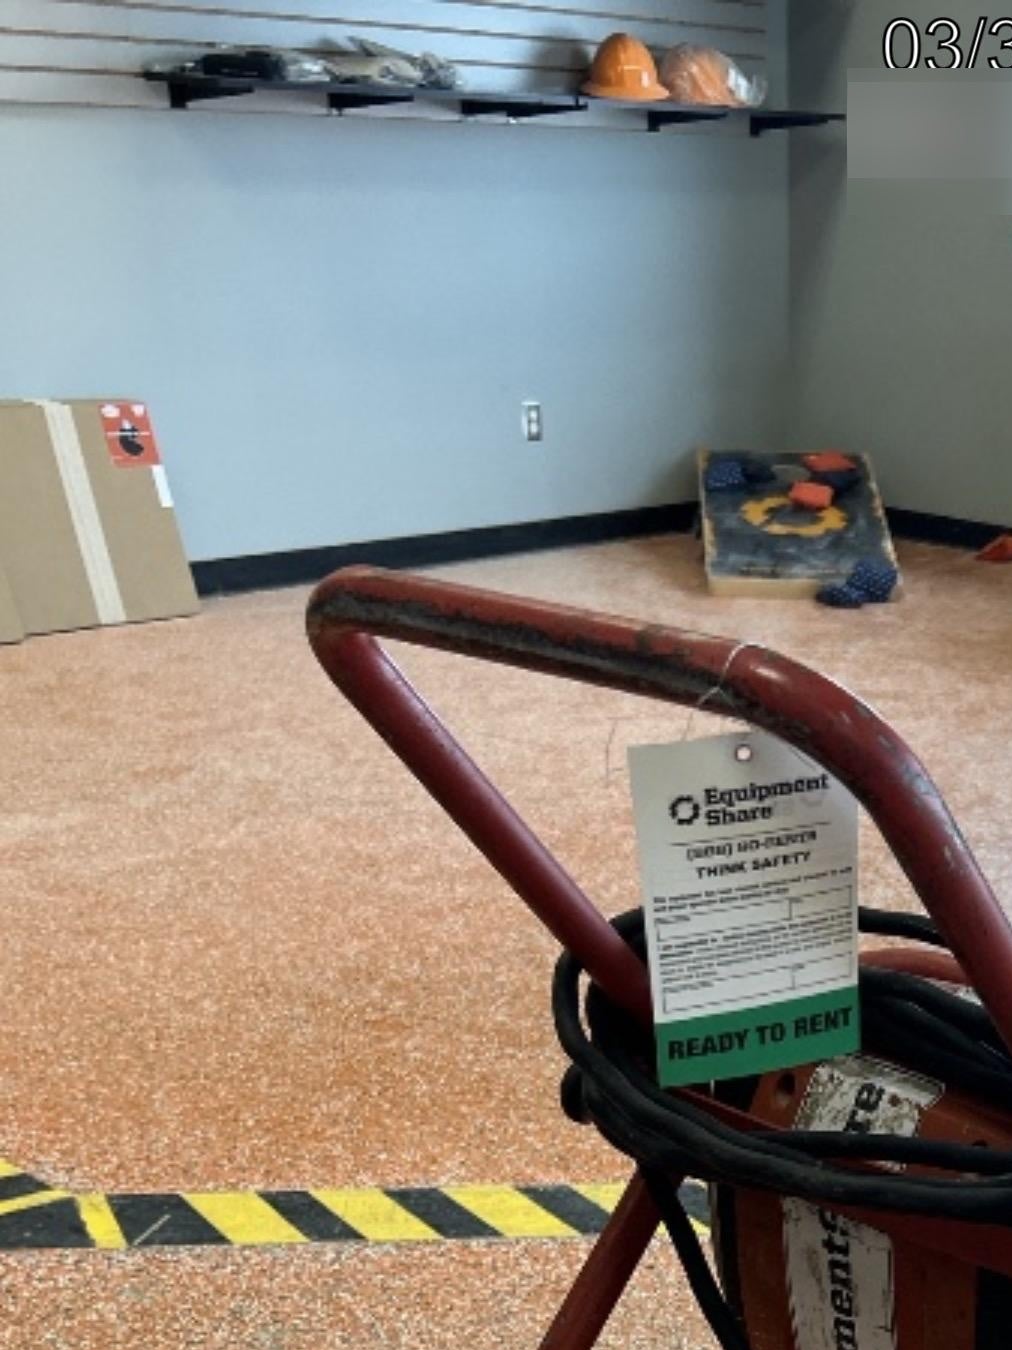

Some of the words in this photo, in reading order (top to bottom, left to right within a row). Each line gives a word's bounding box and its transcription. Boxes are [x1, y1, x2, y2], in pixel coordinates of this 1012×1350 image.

[704, 773, 829, 807] Equipment
[705, 806, 773, 826] Share
[696, 861, 747, 880] THINK
[752, 850, 811, 872] SAFETY
[668, 1028, 750, 1060] READY
[756, 1021, 786, 1047] TO
[794, 1007, 853, 1039] RENT
